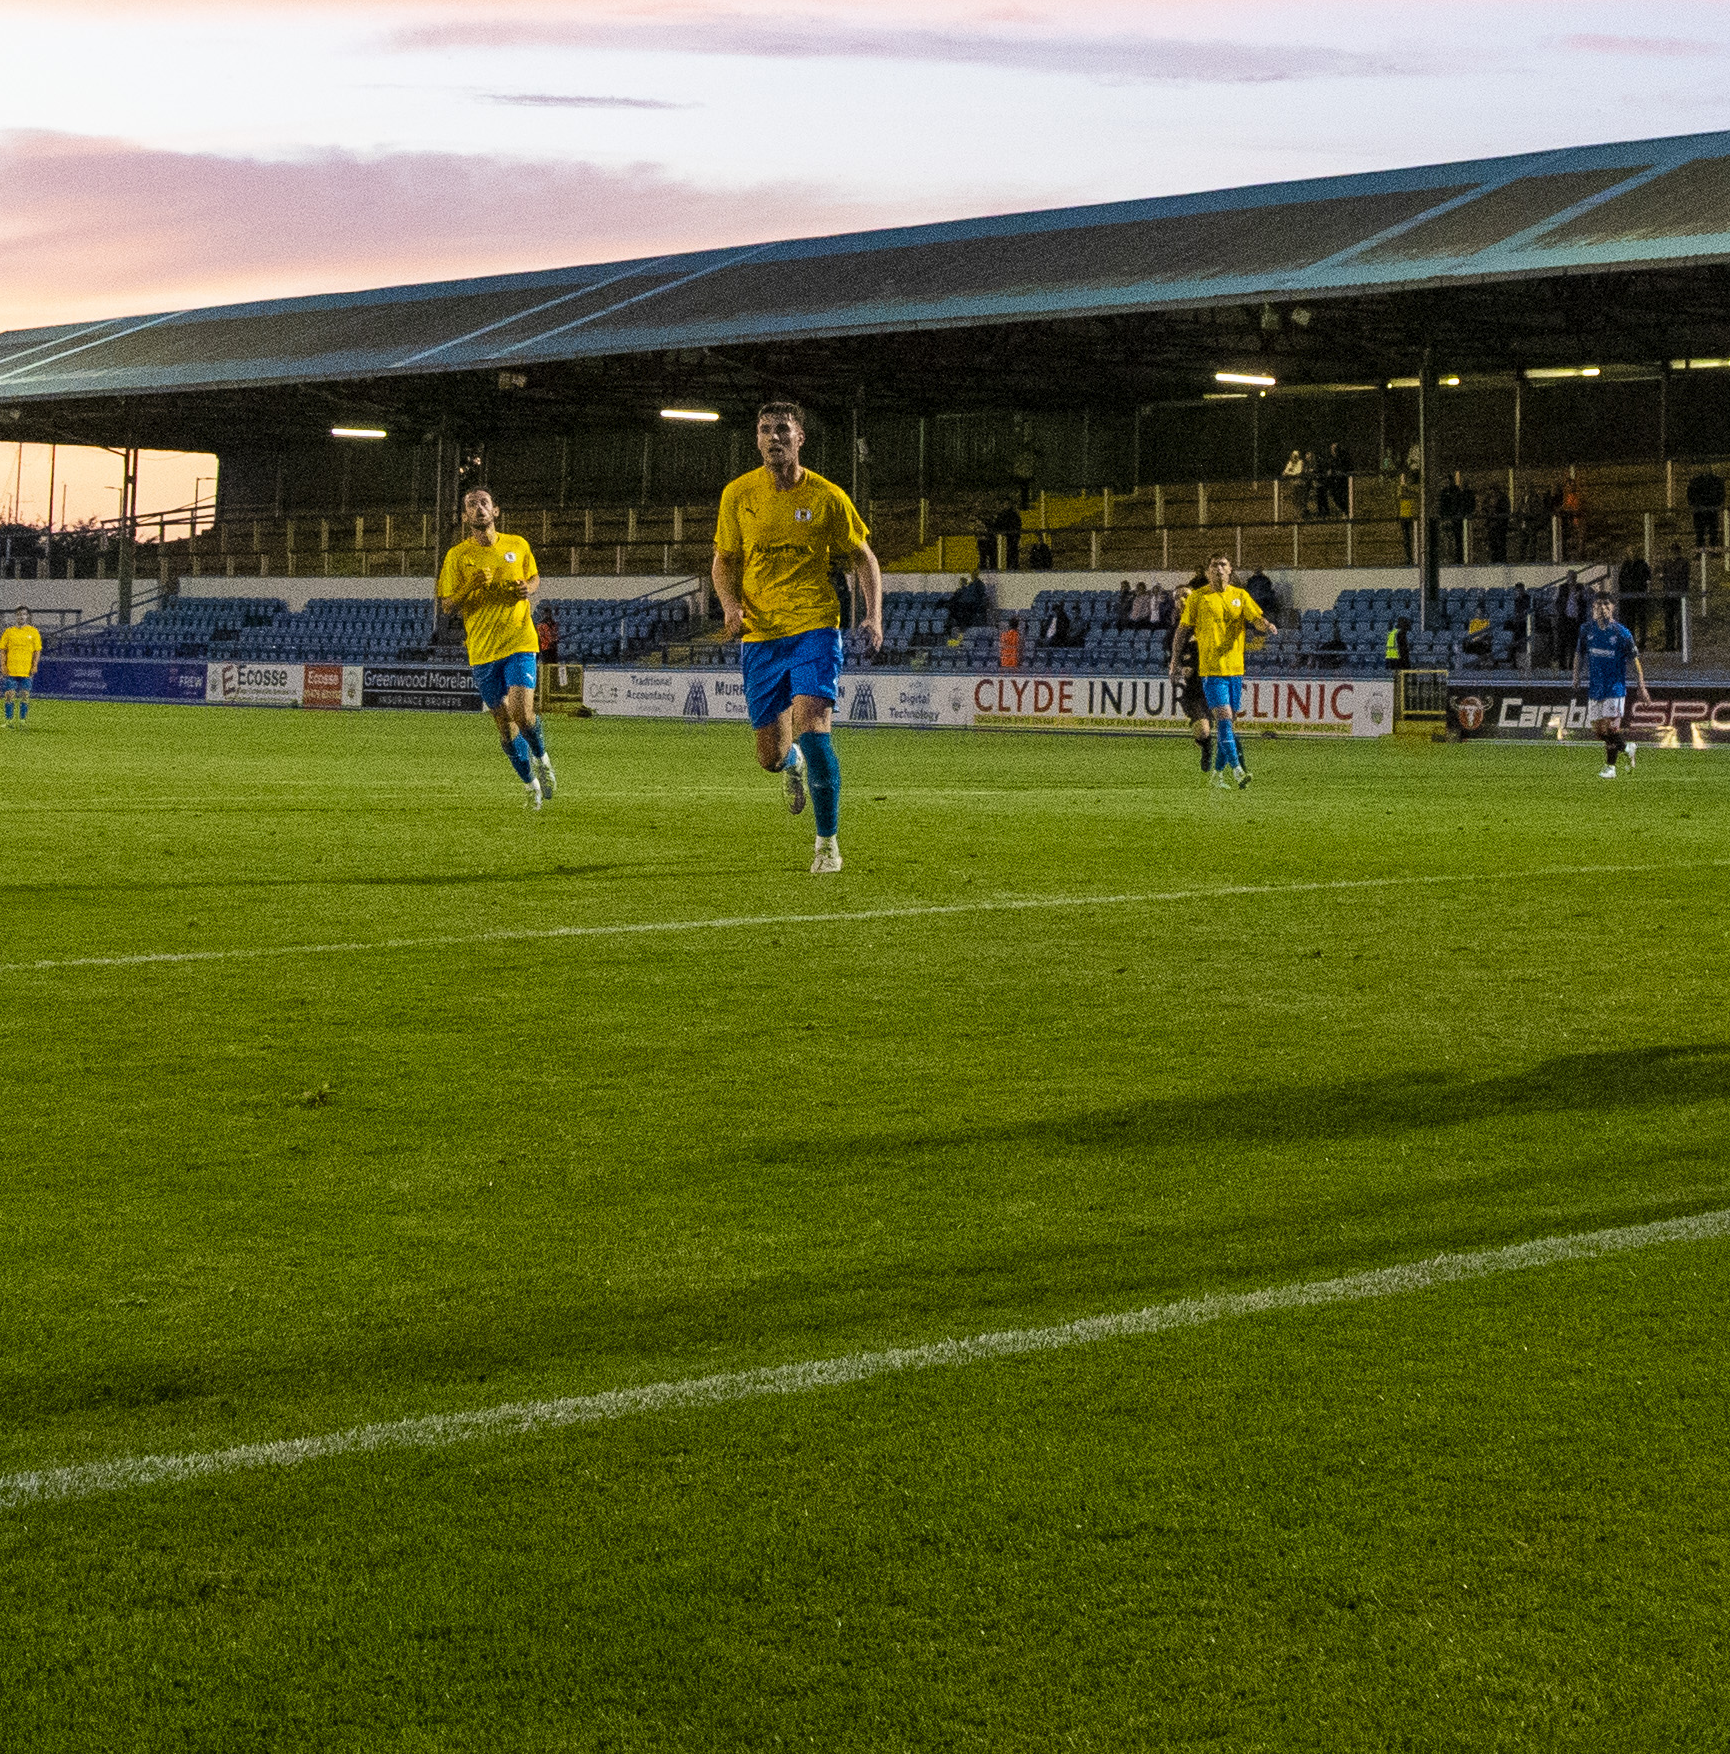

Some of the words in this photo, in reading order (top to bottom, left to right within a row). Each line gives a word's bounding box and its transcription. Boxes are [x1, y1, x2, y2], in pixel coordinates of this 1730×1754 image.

[237, 665, 288, 687] Ecosse
[364, 671, 428, 688] Greenwood
[631, 675, 672, 686] Traditional
[380, 693, 423, 705] INSURANCE
[425, 694, 462, 707] BROKERS
[626, 689, 676, 702] Accountancy
[899, 692, 930, 705] Digital
[974, 678, 1073, 713] CLYDE
[1088, 680, 1187, 717] INJUR
[888, 708, 940, 721] Technology
[1498, 698, 1590, 728] Carab
